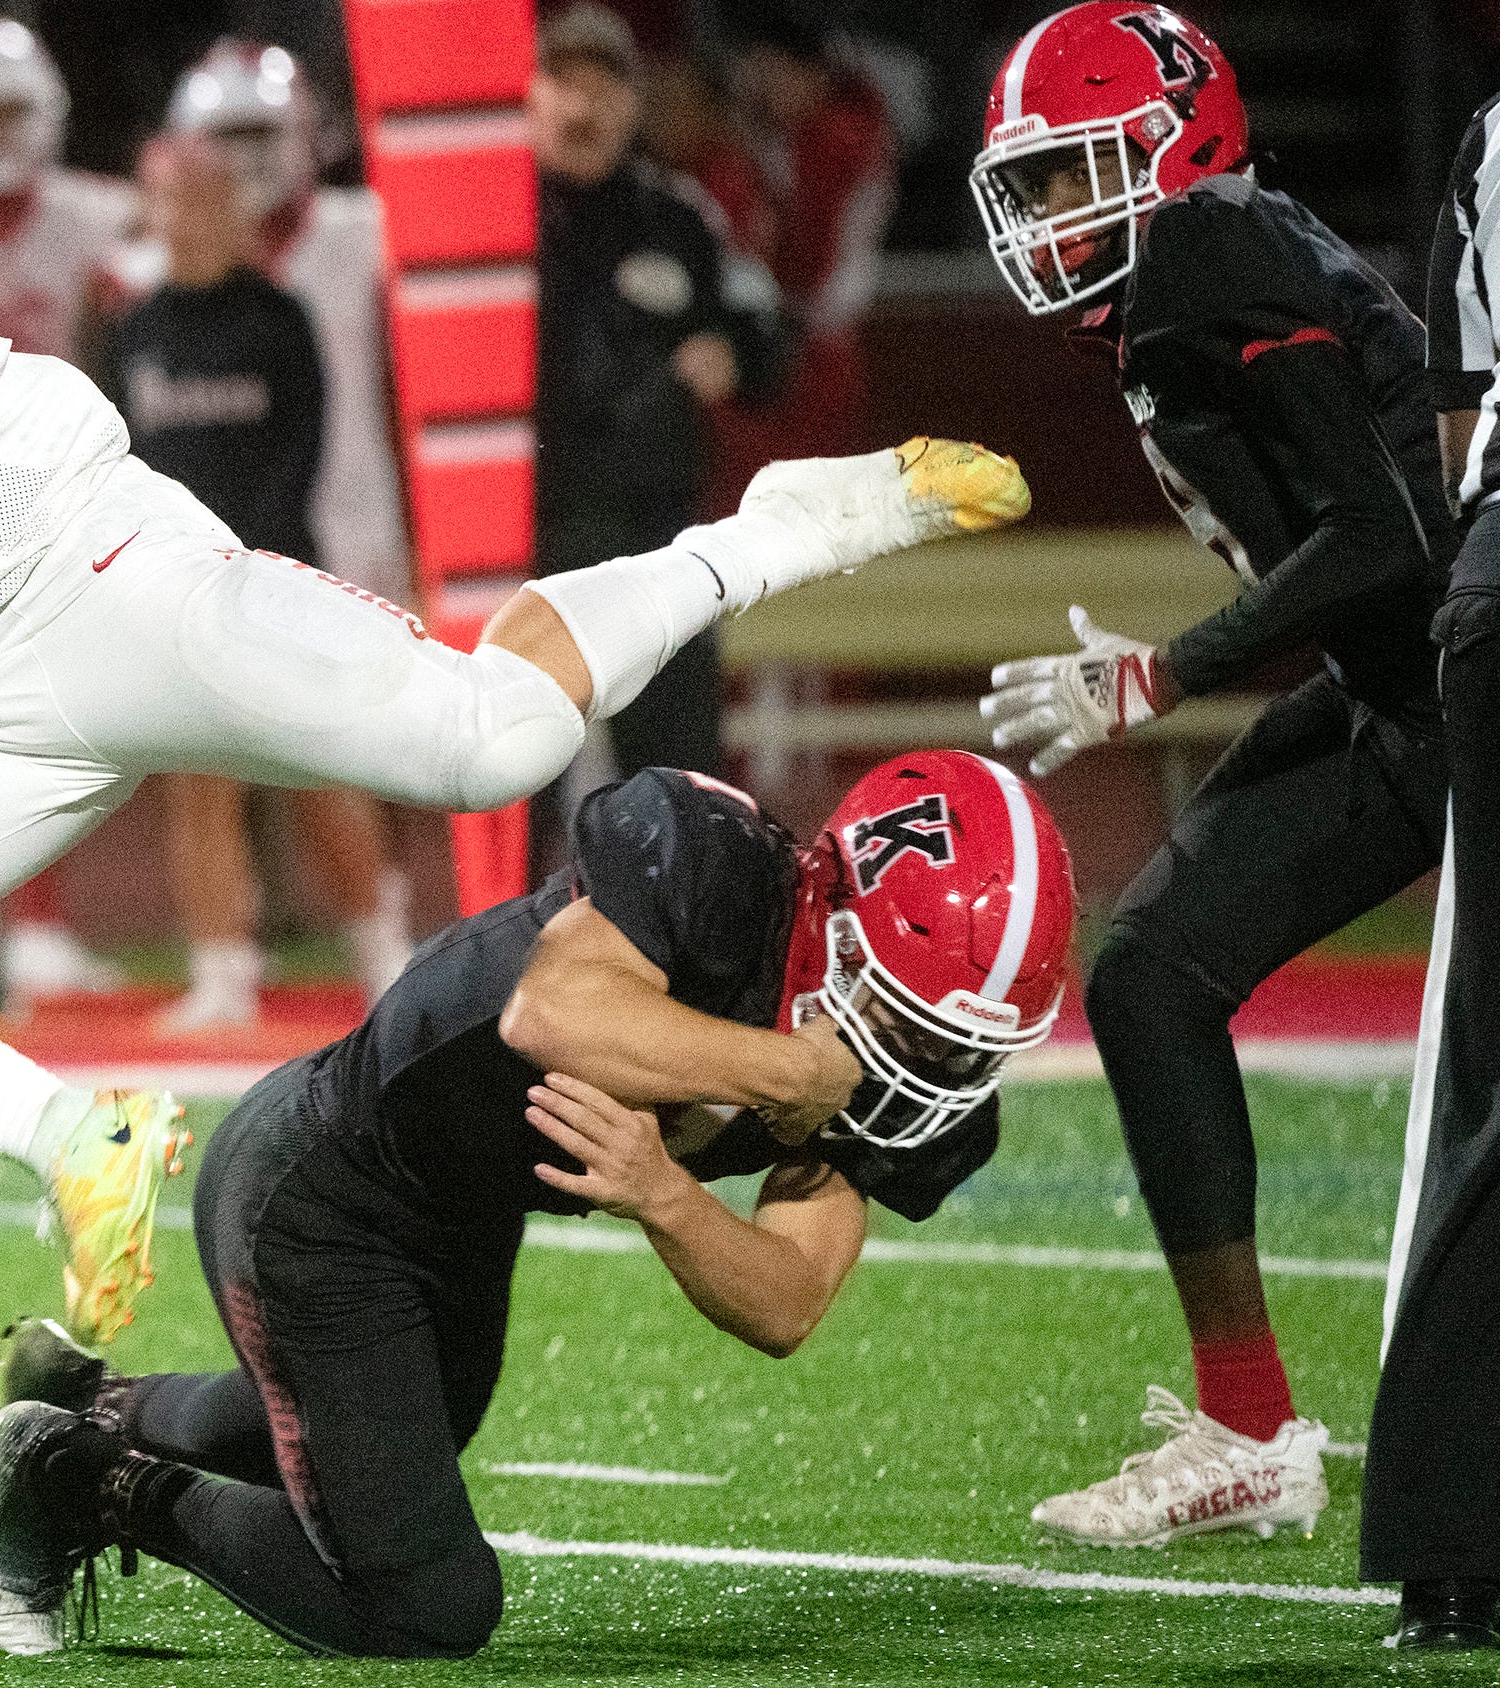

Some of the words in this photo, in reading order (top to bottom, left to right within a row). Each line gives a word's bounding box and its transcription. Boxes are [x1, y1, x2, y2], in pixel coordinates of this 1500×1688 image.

[1110, 9, 1219, 88] K
[992, 119, 1036, 144] Riddell
[842, 793, 956, 897] K
[955, 999, 1015, 1024] Riddell
